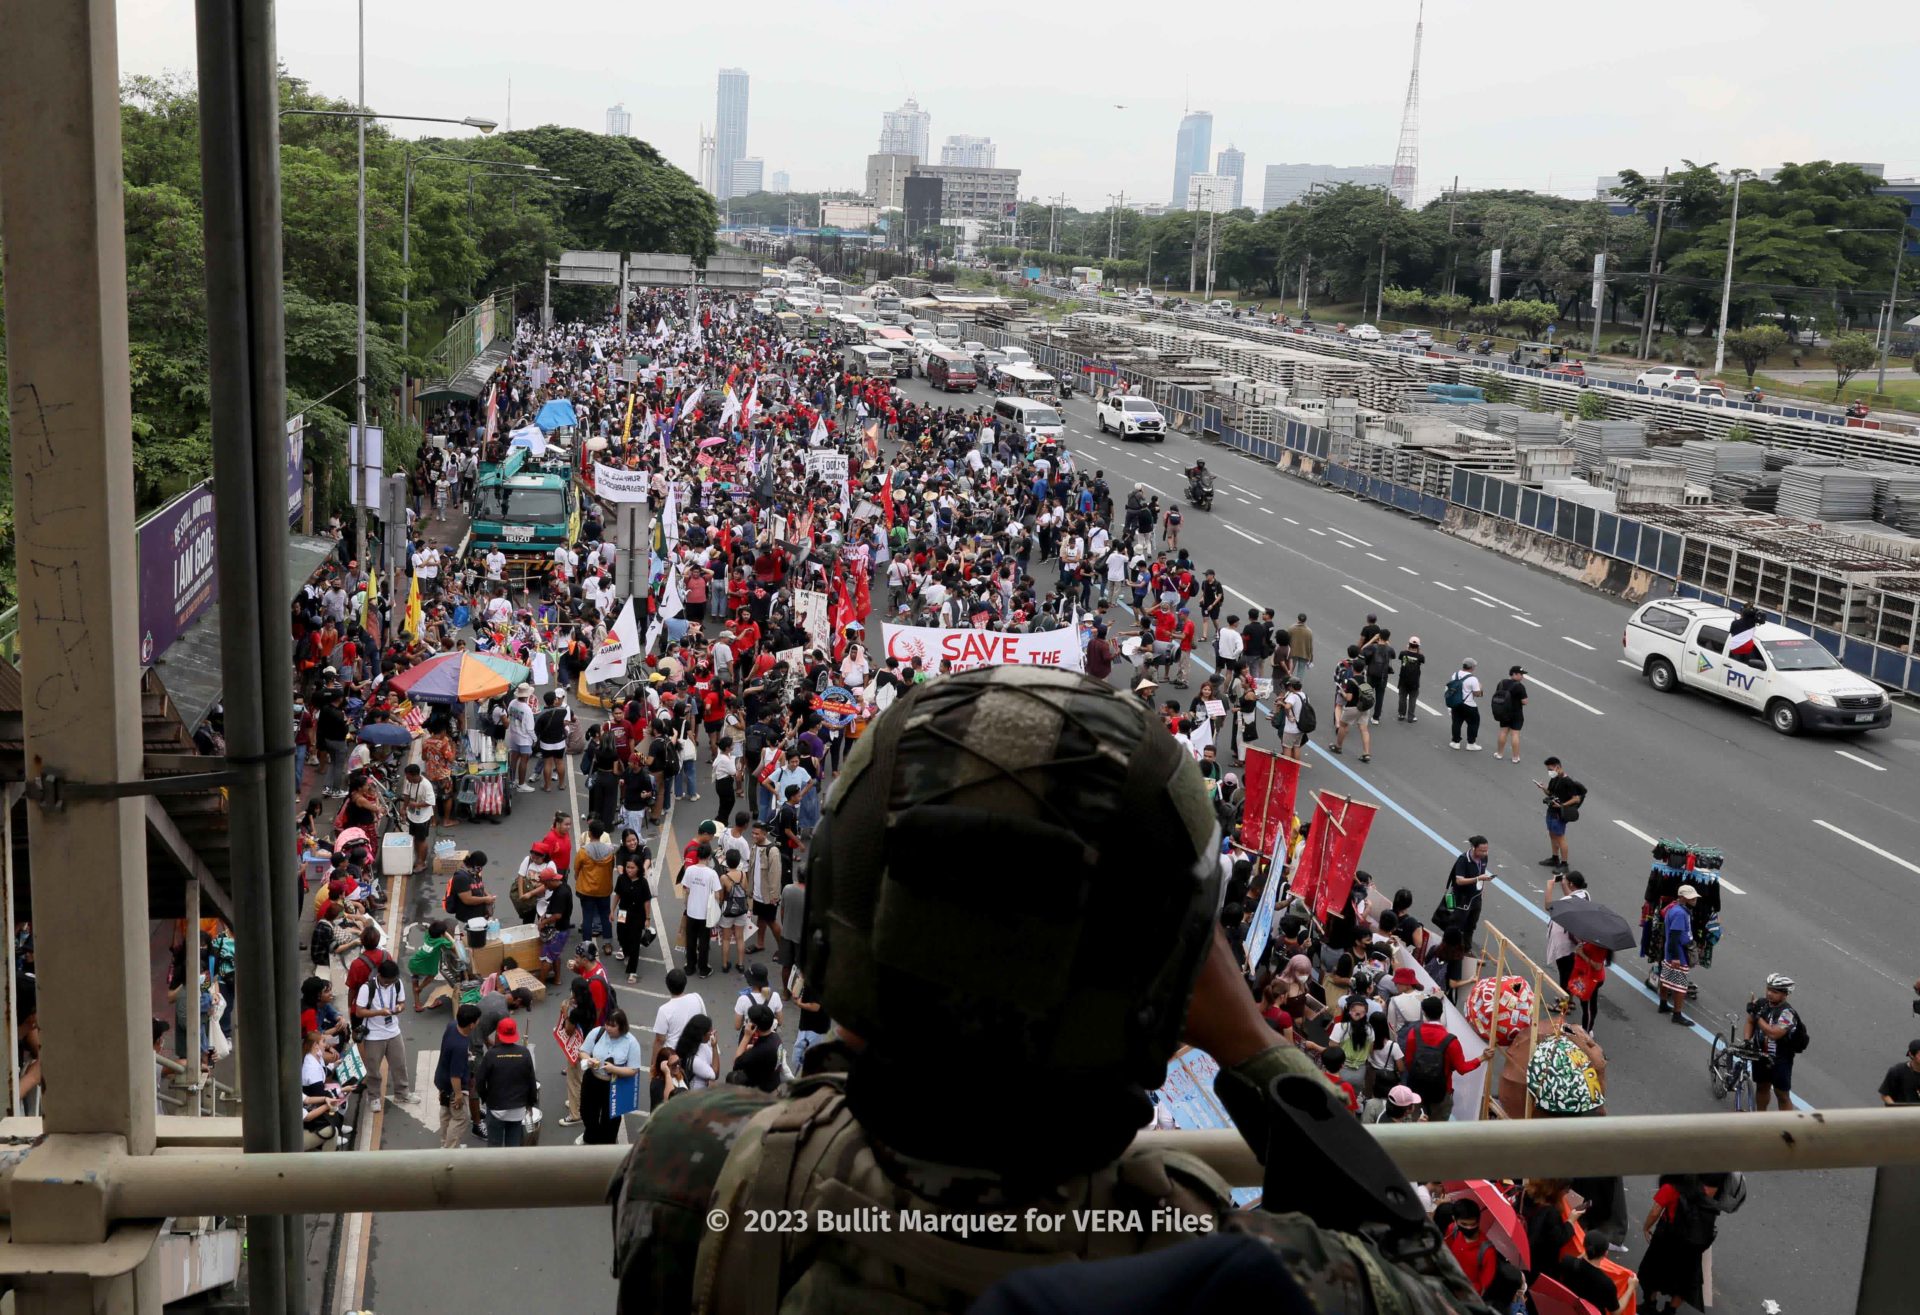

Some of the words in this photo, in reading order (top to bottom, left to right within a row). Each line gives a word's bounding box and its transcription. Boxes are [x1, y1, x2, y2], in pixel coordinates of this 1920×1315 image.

[179, 543, 194, 595] AM
[942, 633, 1020, 664] SAVE
[1028, 650, 1061, 665] THE
[1726, 669, 1755, 691] PTV
